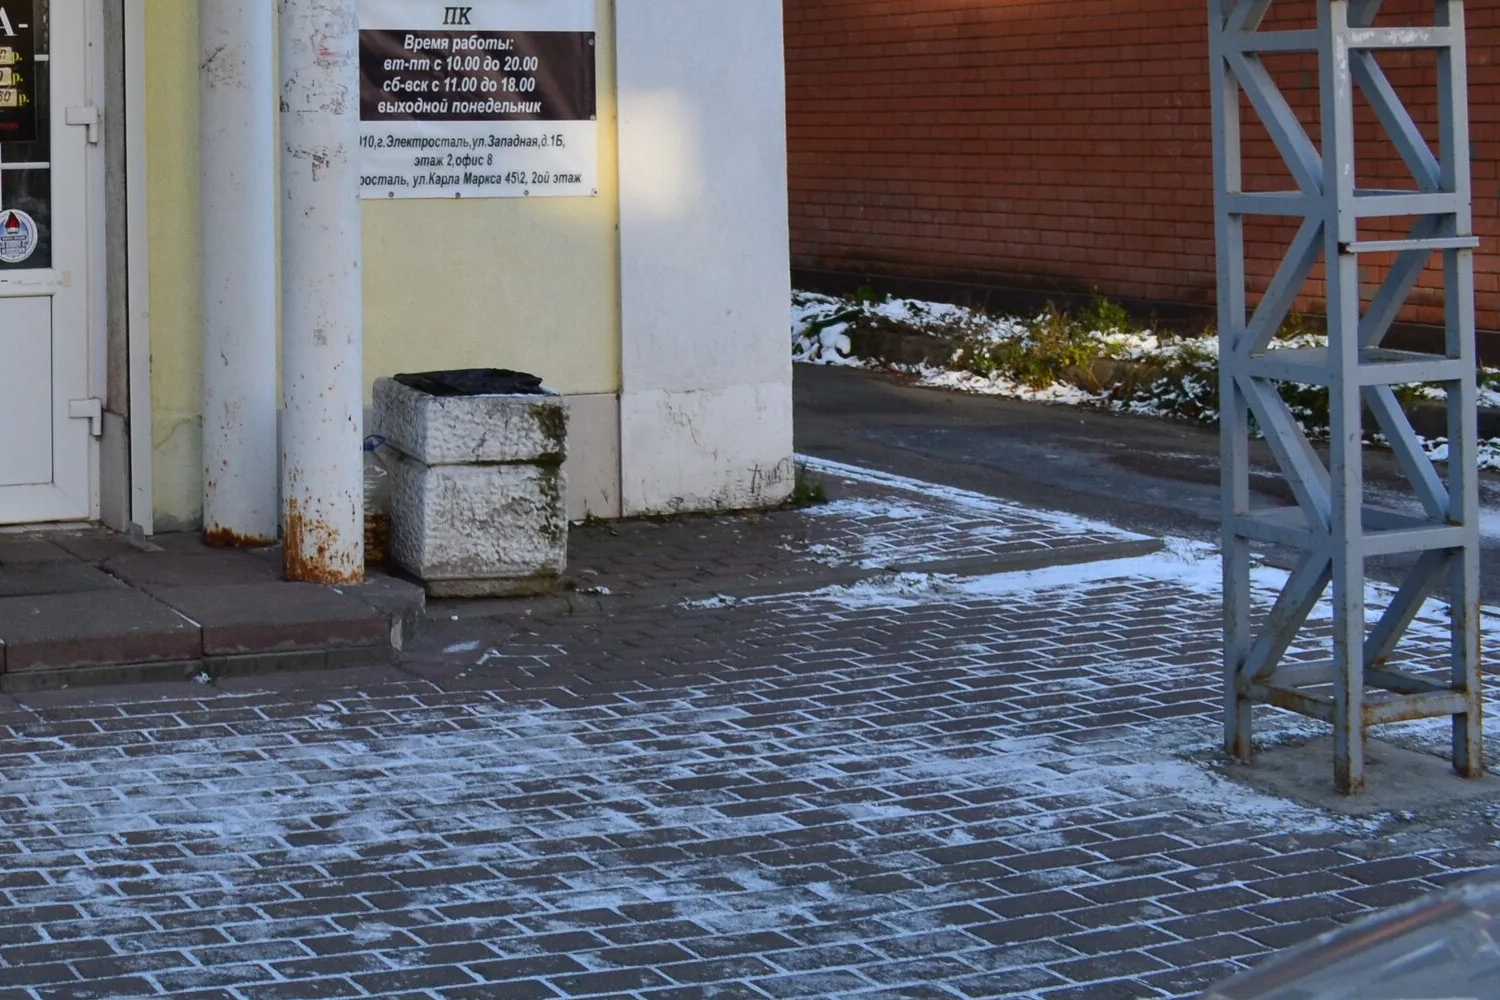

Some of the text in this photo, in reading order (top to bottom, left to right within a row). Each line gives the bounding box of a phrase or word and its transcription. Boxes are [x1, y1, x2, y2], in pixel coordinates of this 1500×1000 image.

[443, 7, 472, 25] ПК
[404, 34, 514, 53] Время работы:
[383, 56, 538, 71] вт-пт с 10.00 до 20.00
[383, 77, 535, 92] сб-вск с 11.00 до 18.00
[378, 99, 542, 113] выходной понедельник
[414, 155, 443, 167] этаж
[486, 153, 493, 166] 8
[412, 171, 459, 188] ул.Карла
[463, 171, 502, 185] Маркса
[531, 171, 550, 185] 2ой
[553, 173, 582, 184] этаж
